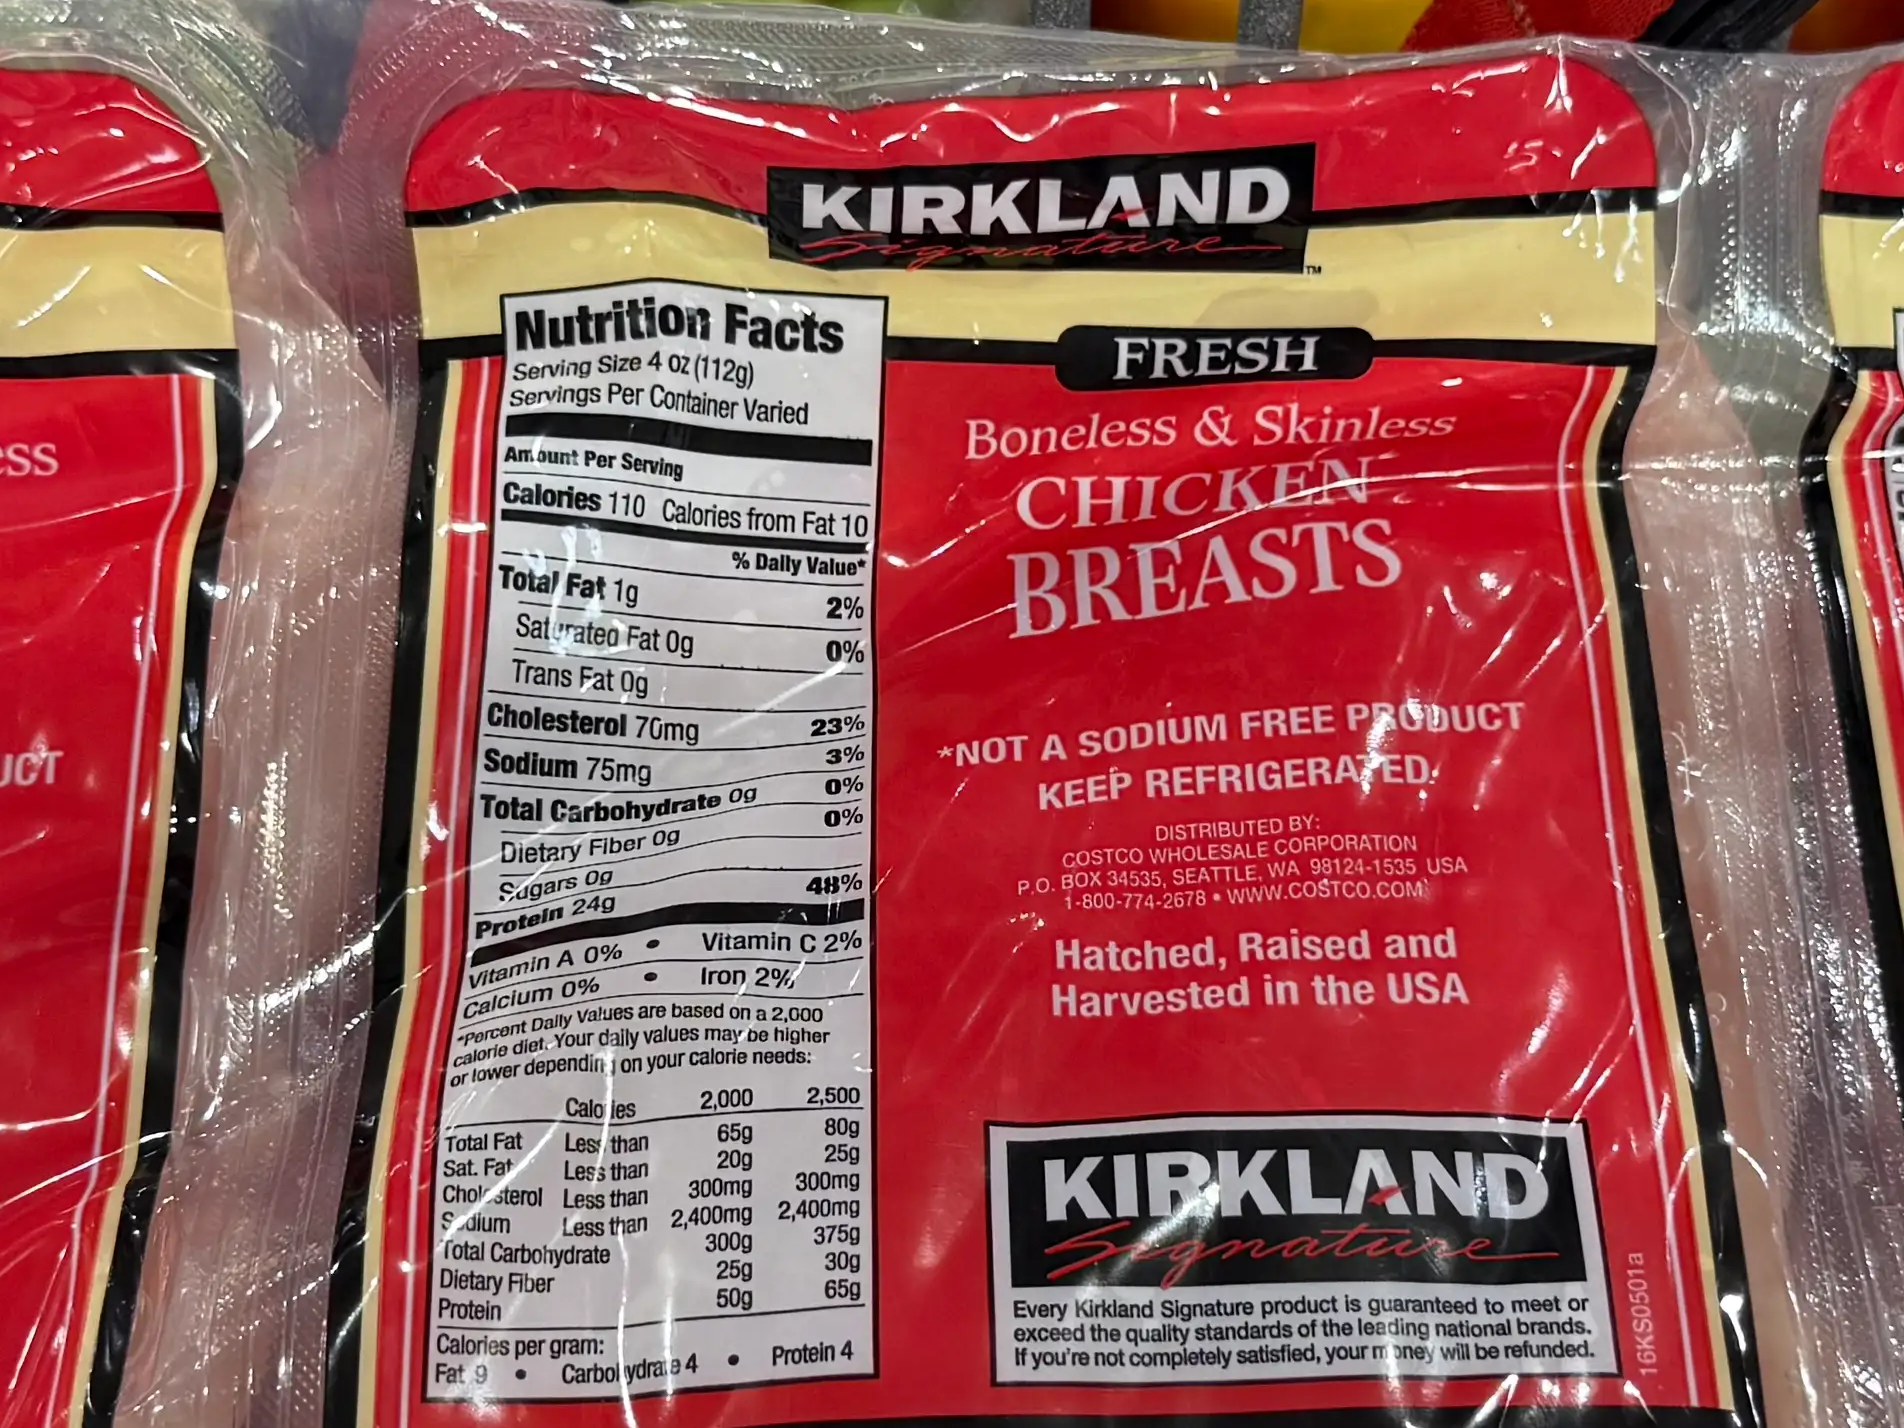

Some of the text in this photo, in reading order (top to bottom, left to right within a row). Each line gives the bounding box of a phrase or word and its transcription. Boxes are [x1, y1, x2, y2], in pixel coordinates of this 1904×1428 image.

[802, 166, 1291, 236] KIRKLAND
[802, 232, 1284, 273] Signature
[515, 297, 844, 354] Nutrition Facts
[513, 352, 754, 389] Serving Size 4 oz (112g)
[1113, 335, 1322, 380] FRESH
[510, 384, 809, 425] Servings Per Container Varied
[966, 402, 1458, 460] Boneless & Skinless
[503, 482, 868, 538] Calories 110 Calories from Fat 10
[1016, 454, 1378, 531] CHICKEN
[1008, 517, 1402, 640] BREASTS
[488, 702, 865, 744] Cholesterol 70mg 23%
[1040, 733, 1068, 762] A
[1078, 713, 1228, 756] SODIUM
[1241, 708, 1335, 740] FREE
[1347, 701, 1525, 734] PRODUCT
[1038, 770, 1132, 810] KEEP
[1155, 815, 1320, 841] DISTRIBUTED BY:
[1062, 834, 1418, 869] COSTCO WHOLESALE CORPORATION
[1018, 856, 1468, 896] P.O. BOX 34535, SEATTLE, WA 98124-1535 USA
[1064, 879, 1425, 910] 1-800-774-2678 WWW.COSTCO.COM
[468, 930, 862, 991] Vitamin A 0% Vitamin C 2%
[1055, 927, 1458, 972] Hatched, Raised and
[1051, 971, 1469, 1018] Harvested in the USA
[1044, 1147, 1551, 1222] KIRKLAND
[1044, 1219, 1560, 1291] Signature
[1013, 1294, 1589, 1324] Every Kirkland Signature product is guaranteed to meet or
[1627, 1252, 1658, 1377] 16KS0501a
